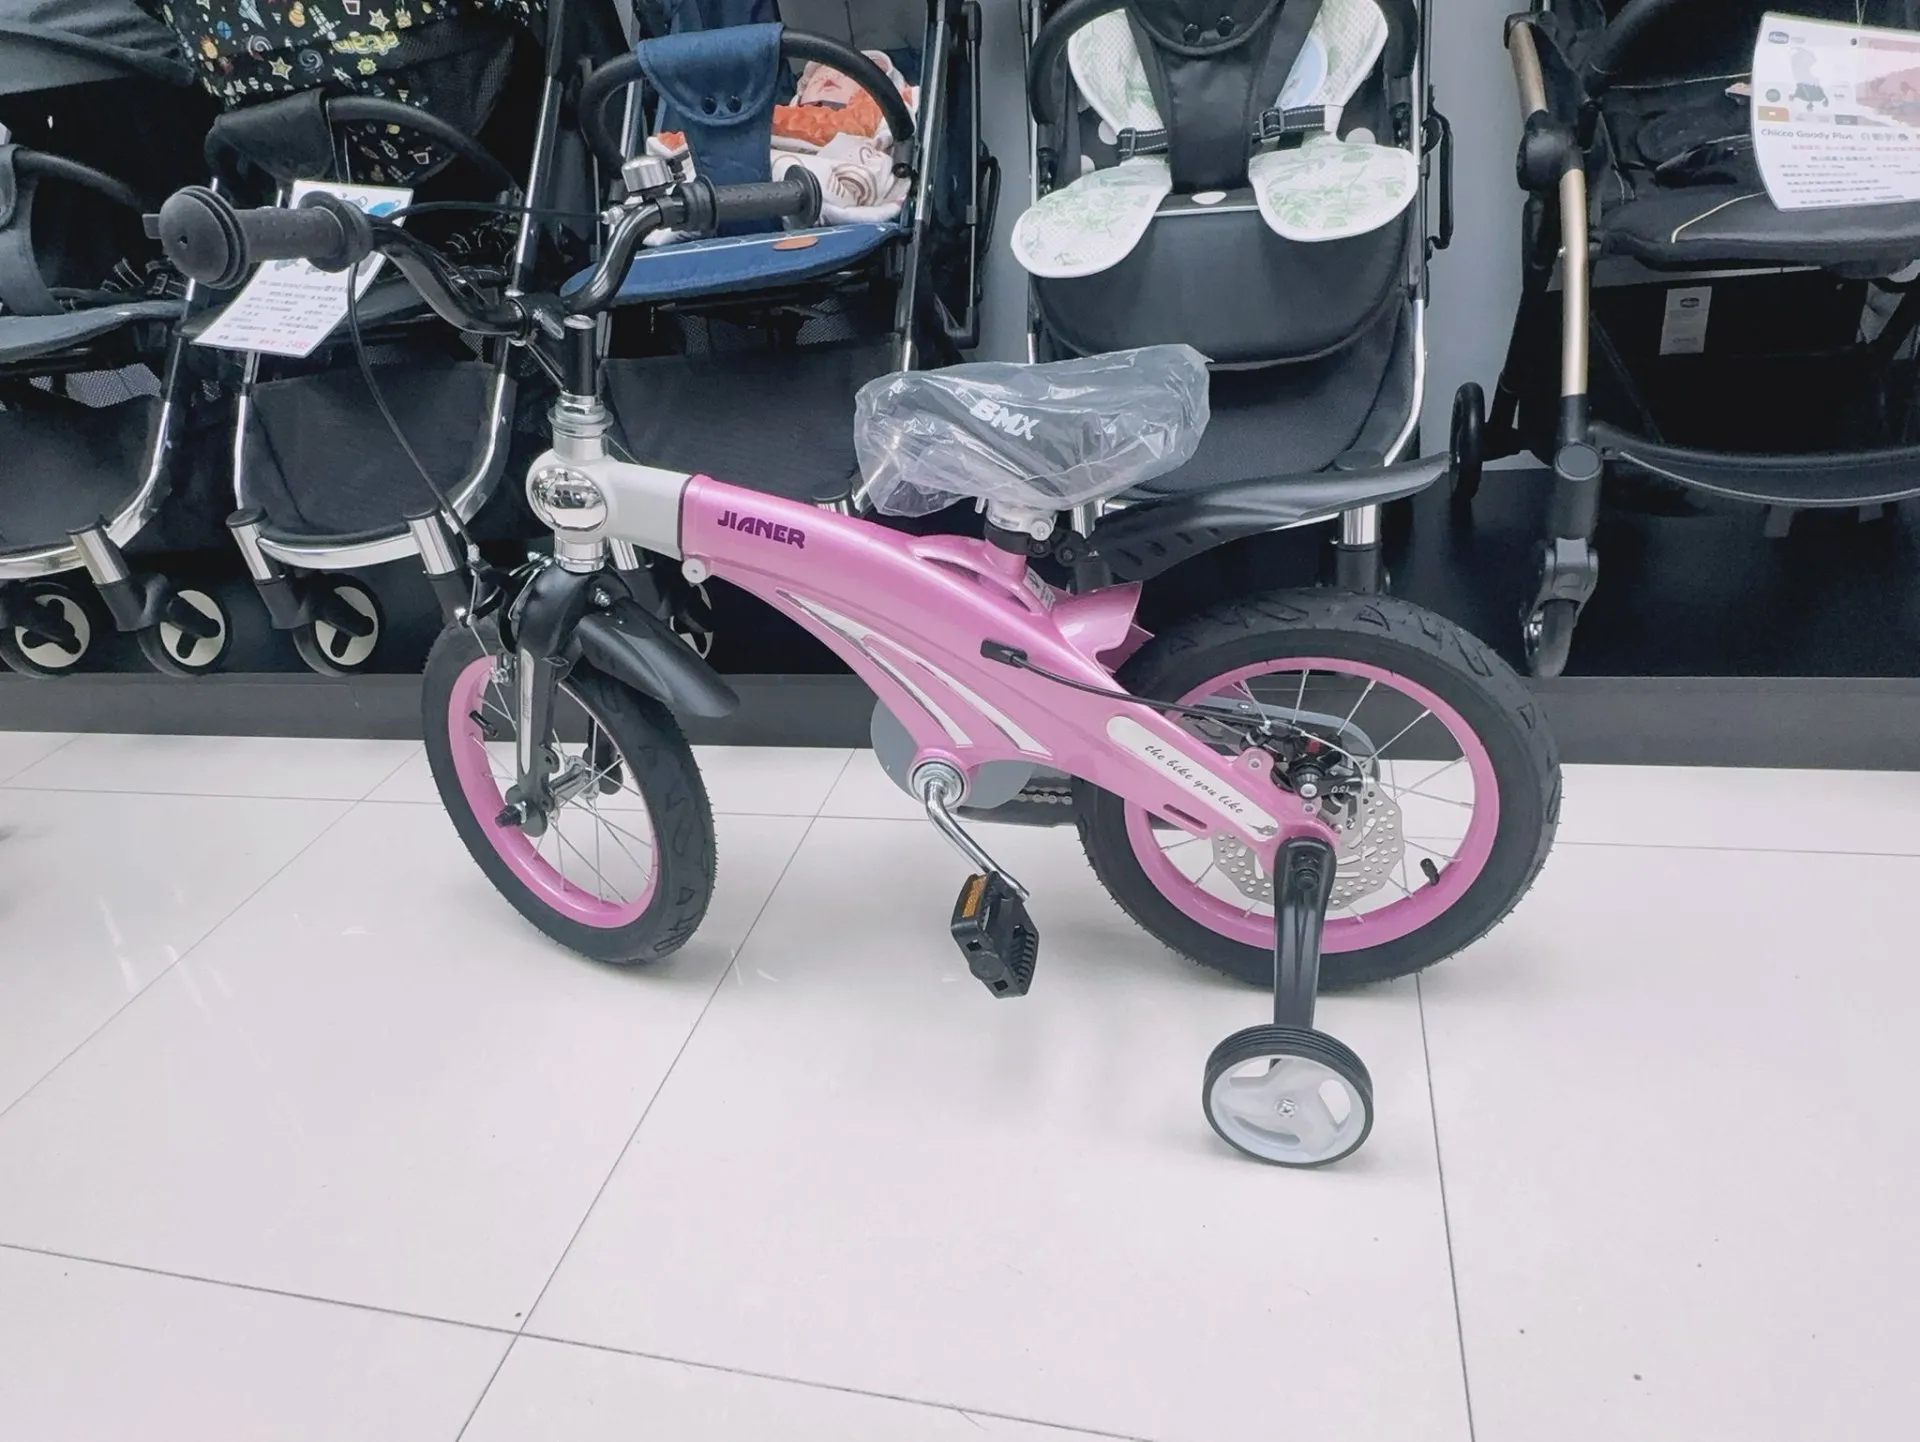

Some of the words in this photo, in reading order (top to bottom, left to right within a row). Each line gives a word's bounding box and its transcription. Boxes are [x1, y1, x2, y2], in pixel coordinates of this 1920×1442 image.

[969, 398, 1041, 441] BMX
[717, 510, 806, 549] JIANER
[1144, 744, 1163, 761] the
[1166, 760, 1194, 781] bike
[1194, 779, 1216, 797] you
[1218, 795, 1245, 814] like
